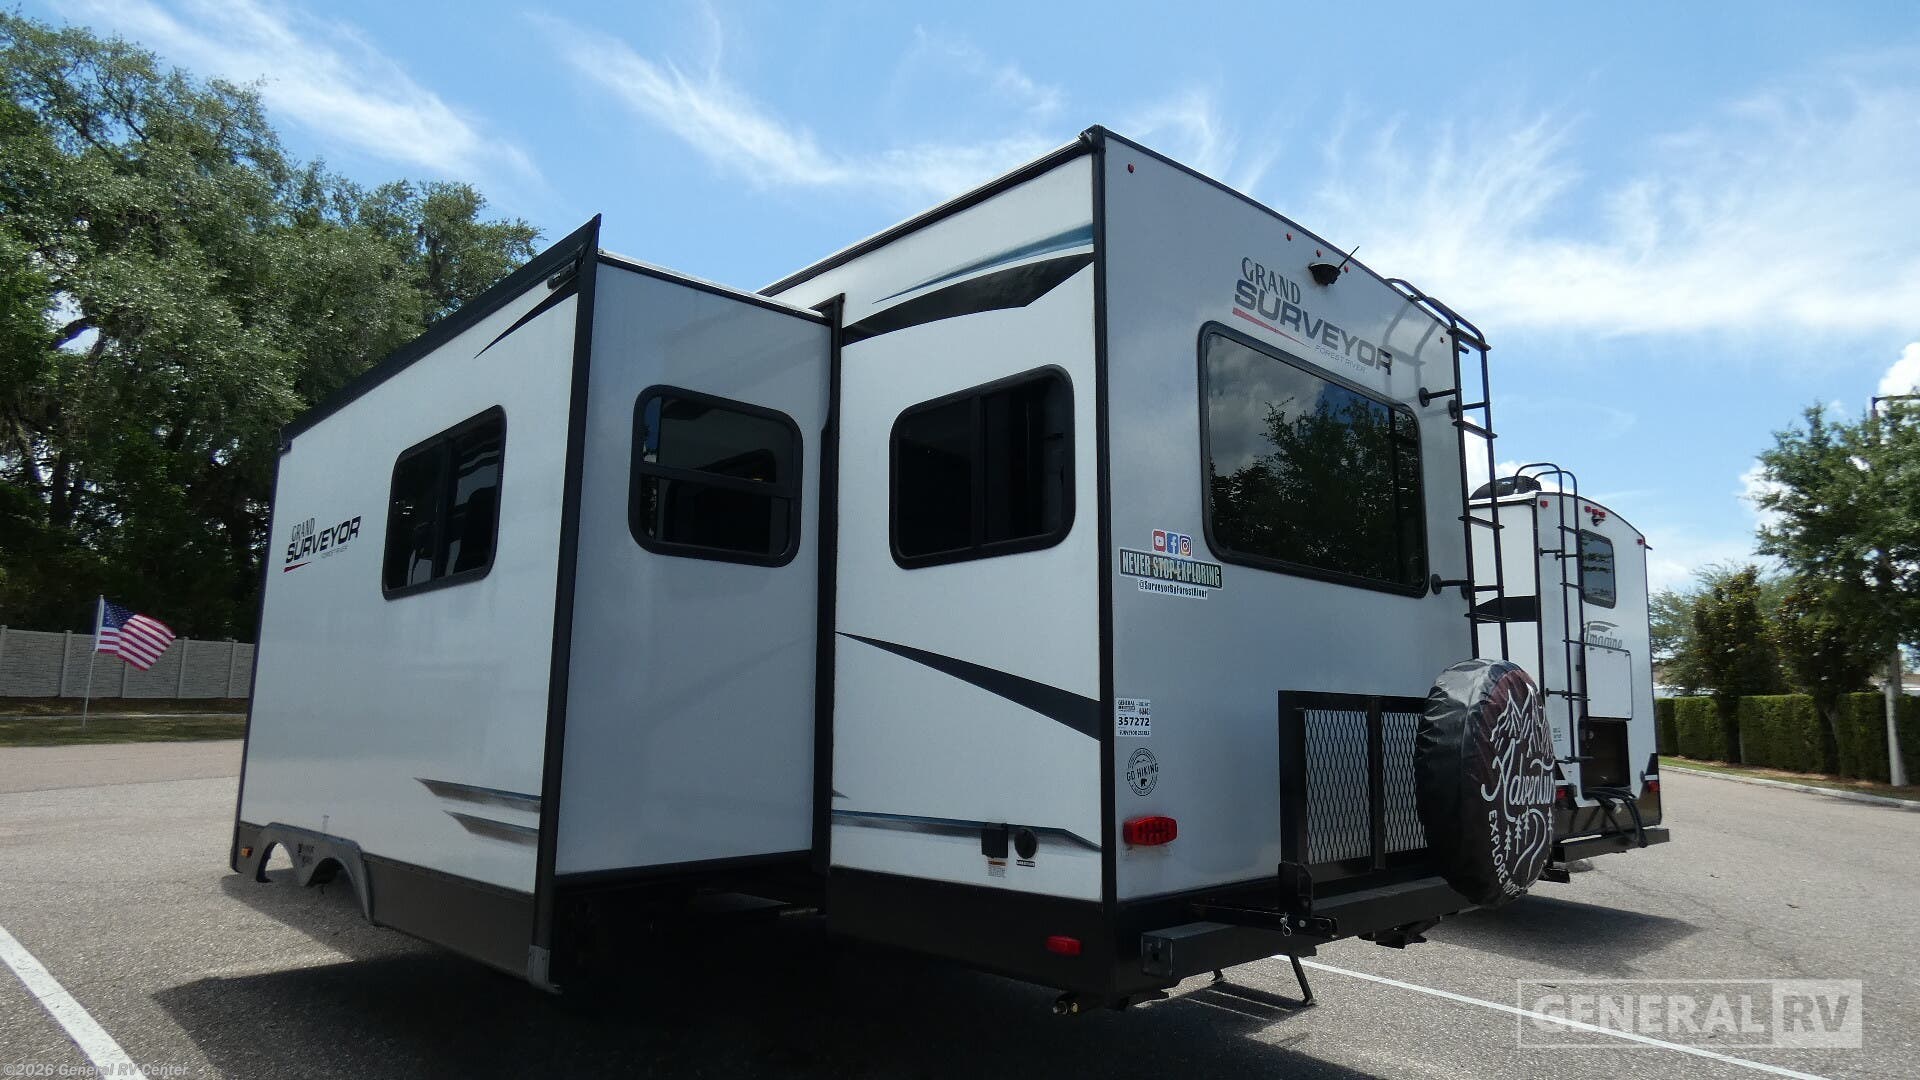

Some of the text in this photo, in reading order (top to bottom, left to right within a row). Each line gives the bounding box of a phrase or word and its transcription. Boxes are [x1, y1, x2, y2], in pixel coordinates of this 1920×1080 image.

[1241, 257, 1301, 304] GRAND
[1233, 279, 1393, 376] SURVEYOR
[286, 515, 362, 564] SURVEYOR
[291, 517, 316, 543] GRAND
[1122, 551, 1151, 577] NEVER
[1176, 560, 1220, 587] EXPLORING
[1118, 716, 1150, 727] 357272
[1126, 762, 1159, 782] GO HIKING
[1488, 809, 1508, 884] EXPLORE
